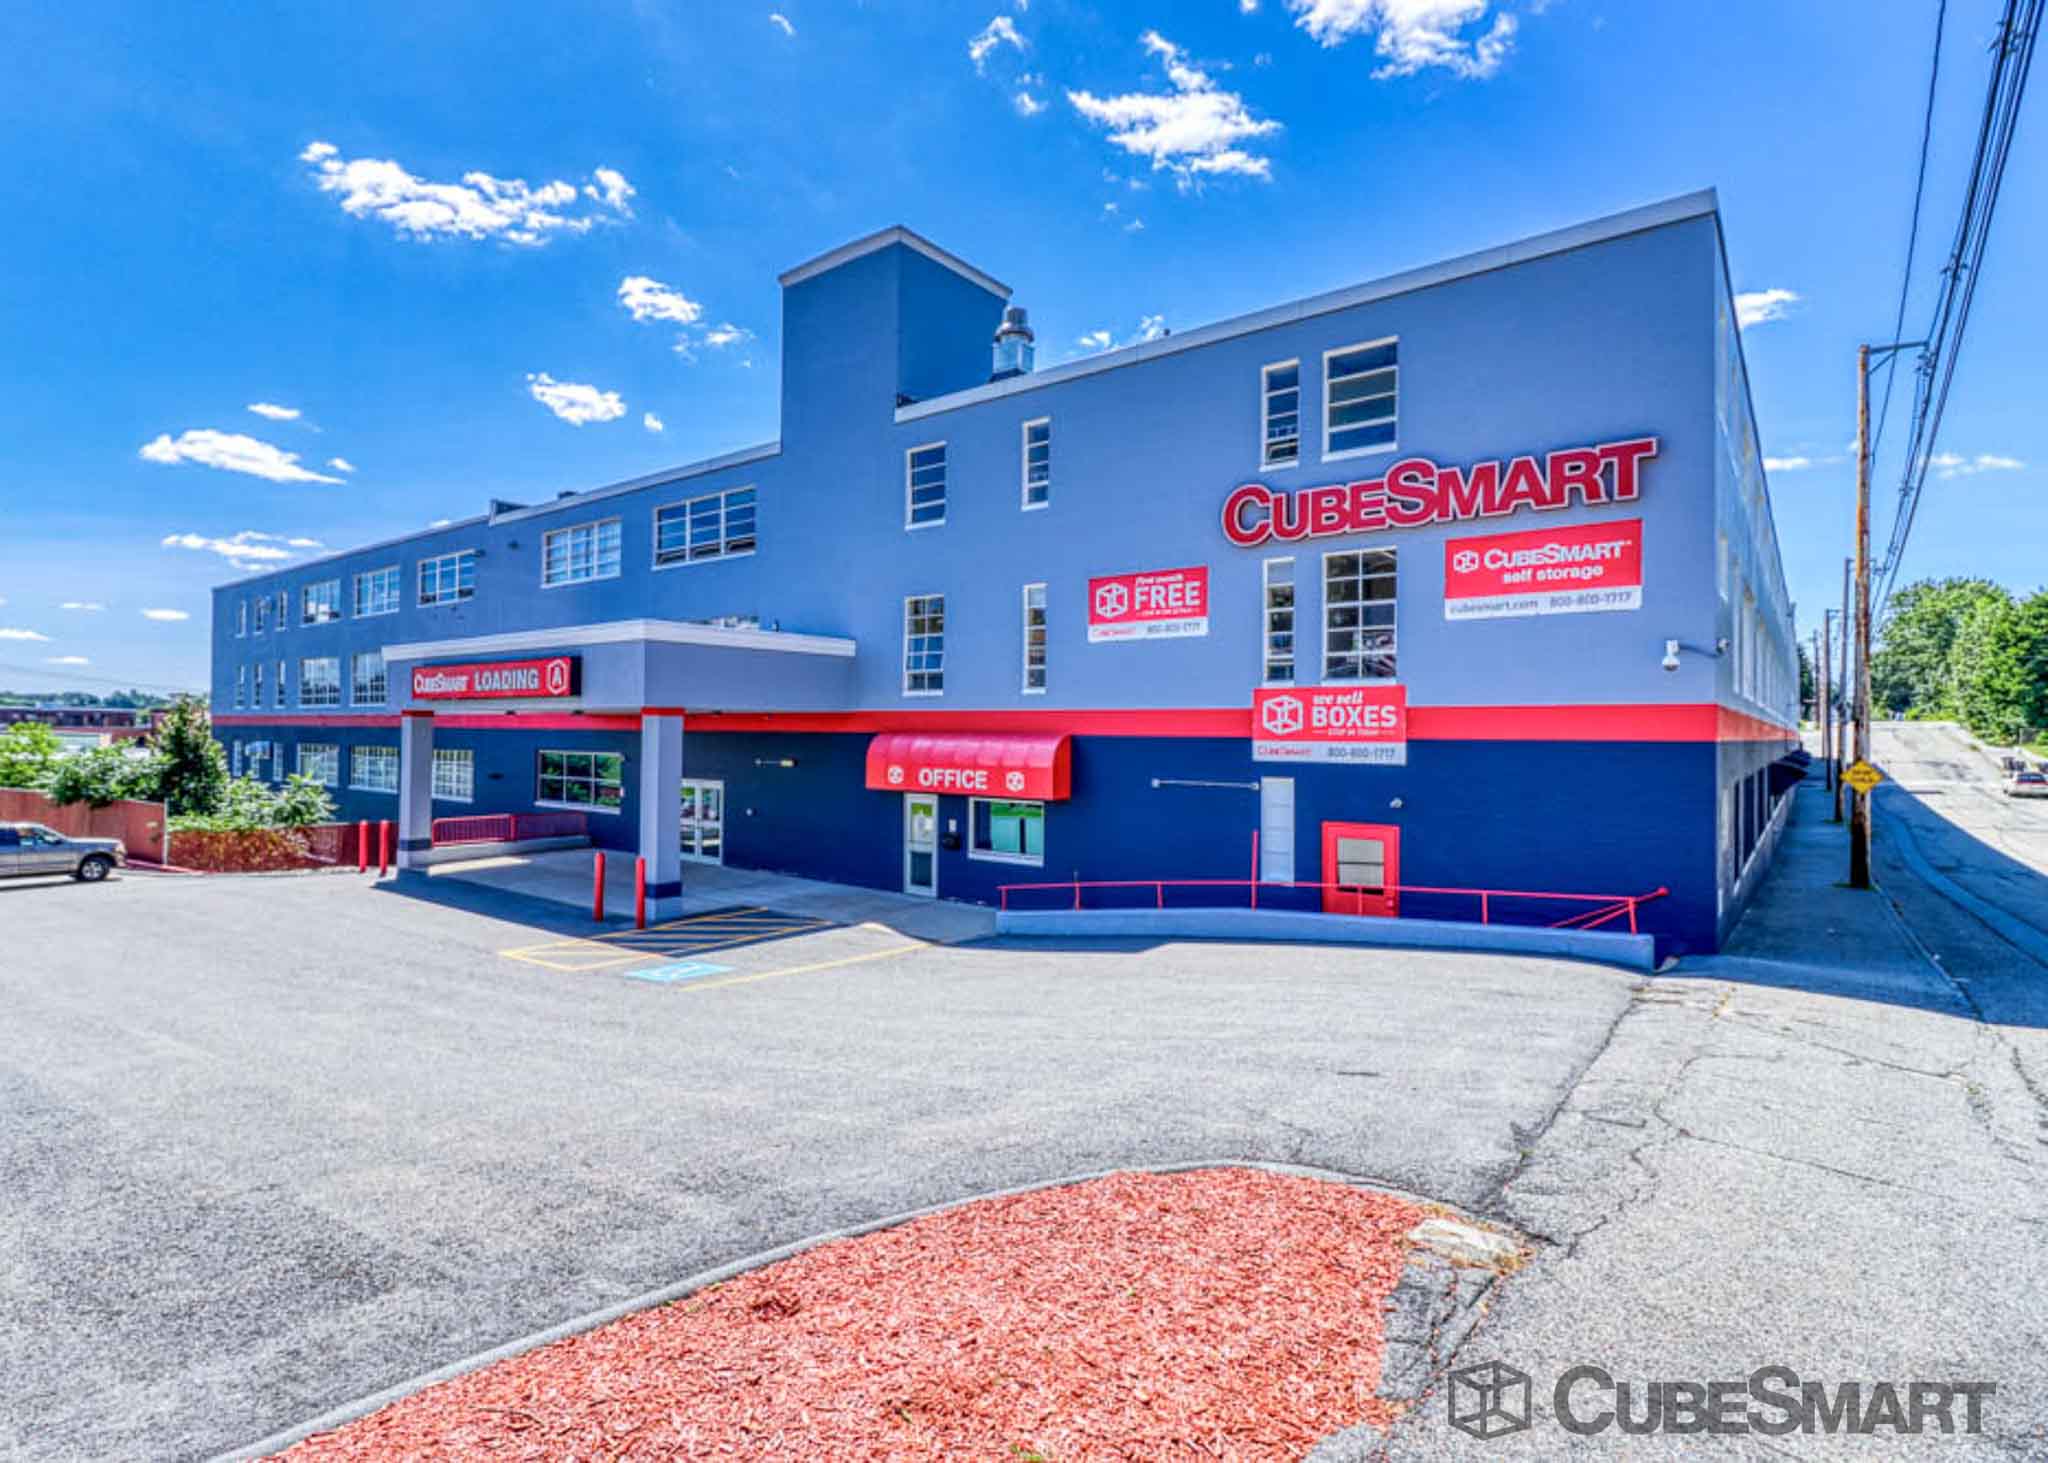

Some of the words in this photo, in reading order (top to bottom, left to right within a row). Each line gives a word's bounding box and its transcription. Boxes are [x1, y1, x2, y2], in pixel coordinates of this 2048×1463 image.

[1503, 569, 1533, 584] self
[1536, 565, 1604, 580] storage
[1135, 581, 1201, 610] FREE
[474, 668, 539, 692] LOADING
[1312, 705, 1398, 728] BOXES
[918, 767, 989, 790] OFFICE
